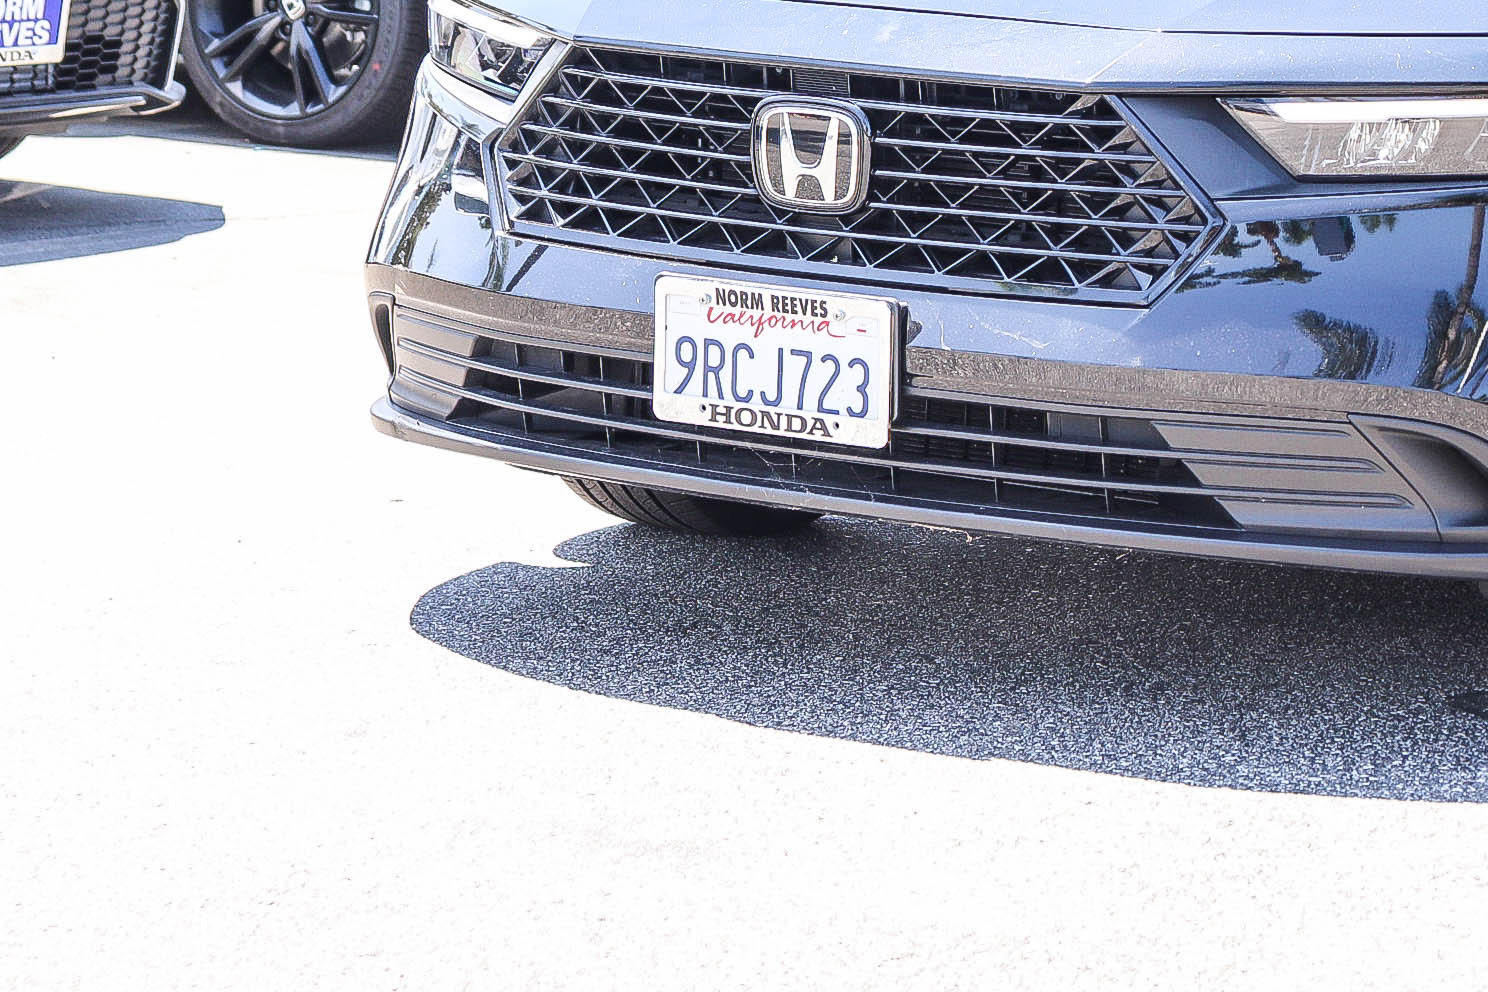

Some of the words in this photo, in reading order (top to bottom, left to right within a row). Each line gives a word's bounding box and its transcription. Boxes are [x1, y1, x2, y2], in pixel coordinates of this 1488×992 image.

[0, 19, 51, 46] VES
[715, 287, 764, 310] NORM
[770, 294, 828, 319] REEVES
[706, 306, 846, 338] California
[673, 335, 870, 419] 9RCJ723
[708, 403, 833, 438] HONDA
